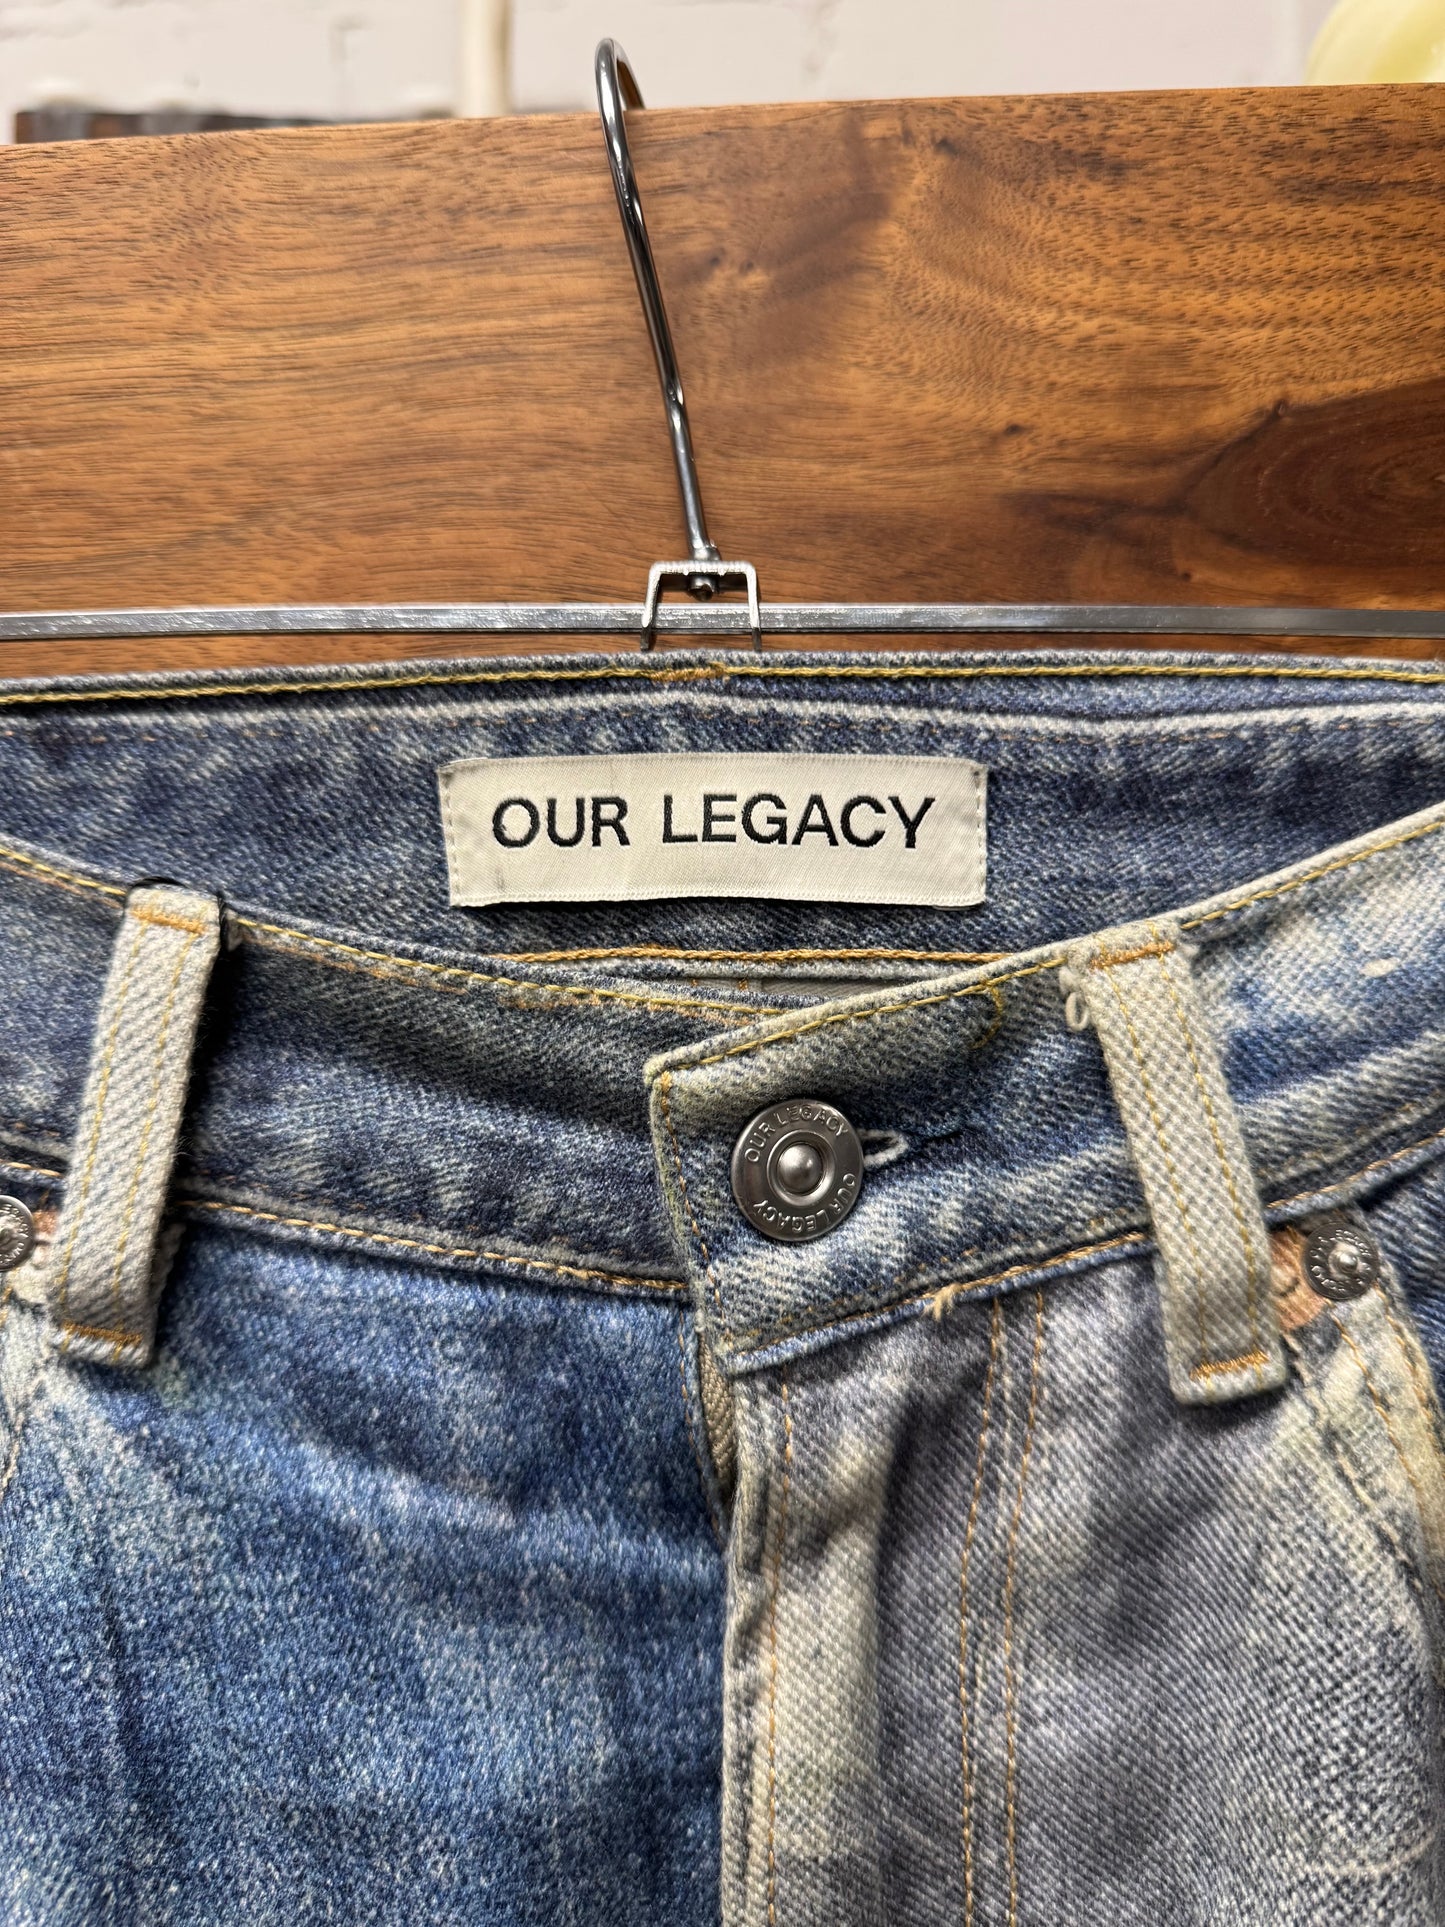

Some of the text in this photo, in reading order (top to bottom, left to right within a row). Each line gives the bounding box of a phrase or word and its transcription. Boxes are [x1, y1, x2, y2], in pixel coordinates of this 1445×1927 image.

[492, 794, 936, 848] OUR LEGACY
[745, 1105, 849, 1162] OUR LEGACY
[753, 1173, 856, 1233] OUR LEGACY
